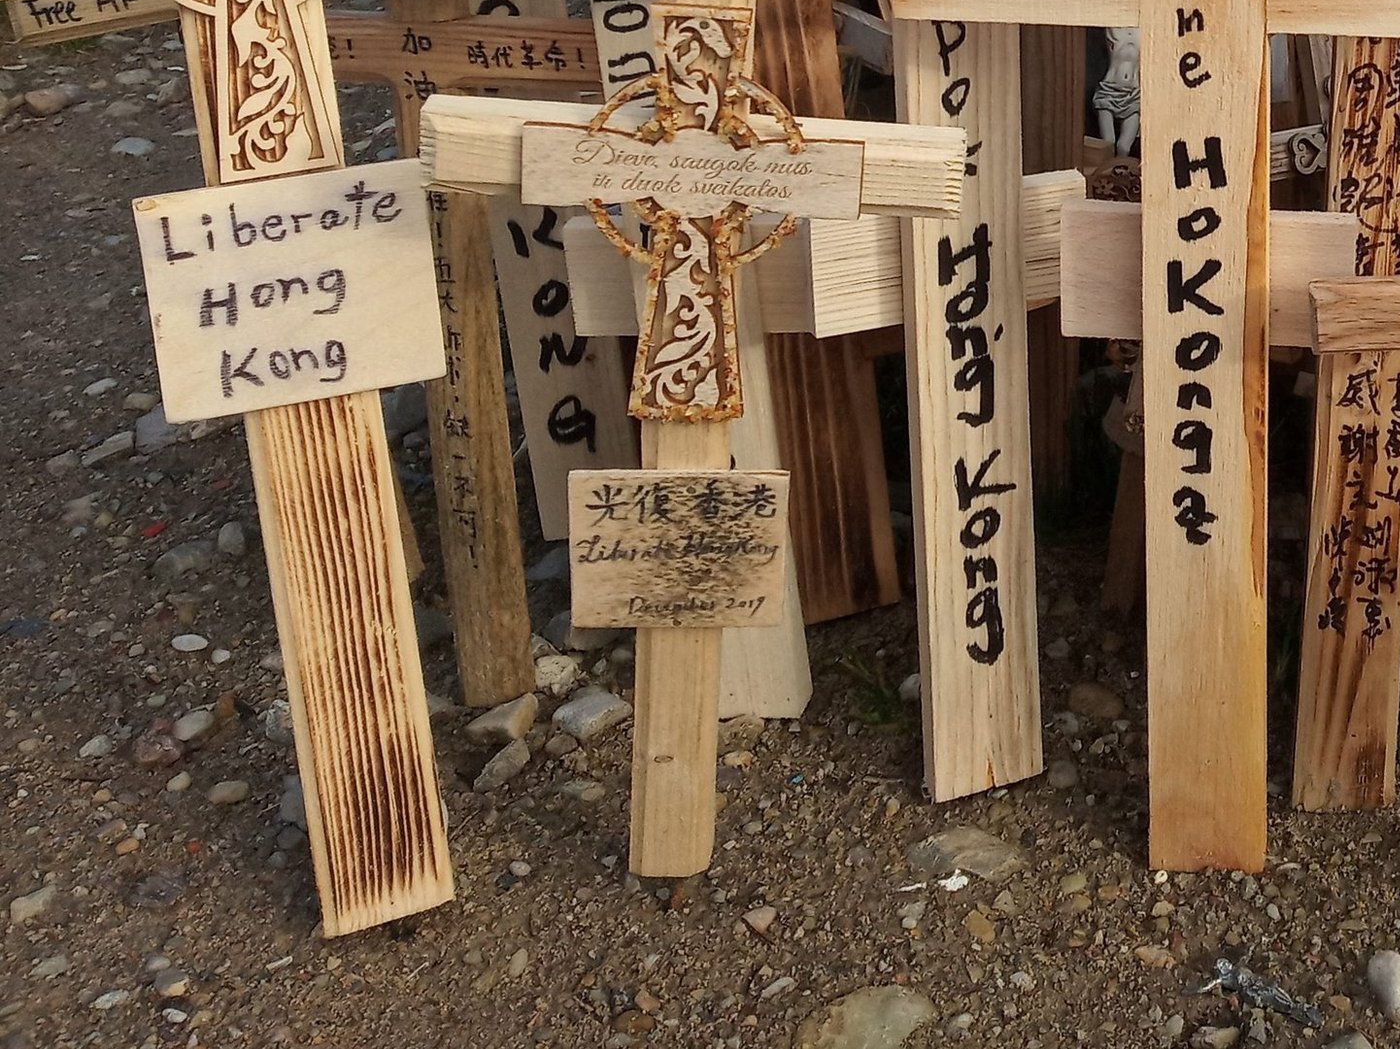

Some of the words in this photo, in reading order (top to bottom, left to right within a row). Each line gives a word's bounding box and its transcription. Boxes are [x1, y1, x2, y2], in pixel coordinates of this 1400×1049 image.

[622, 170, 683, 194] duok
[669, 154, 758, 179] saugok
[163, 181, 403, 268] Liberate
[200, 268, 347, 328] Hong
[219, 339, 348, 398] Kong
[954, 446, 1017, 664] Kong
